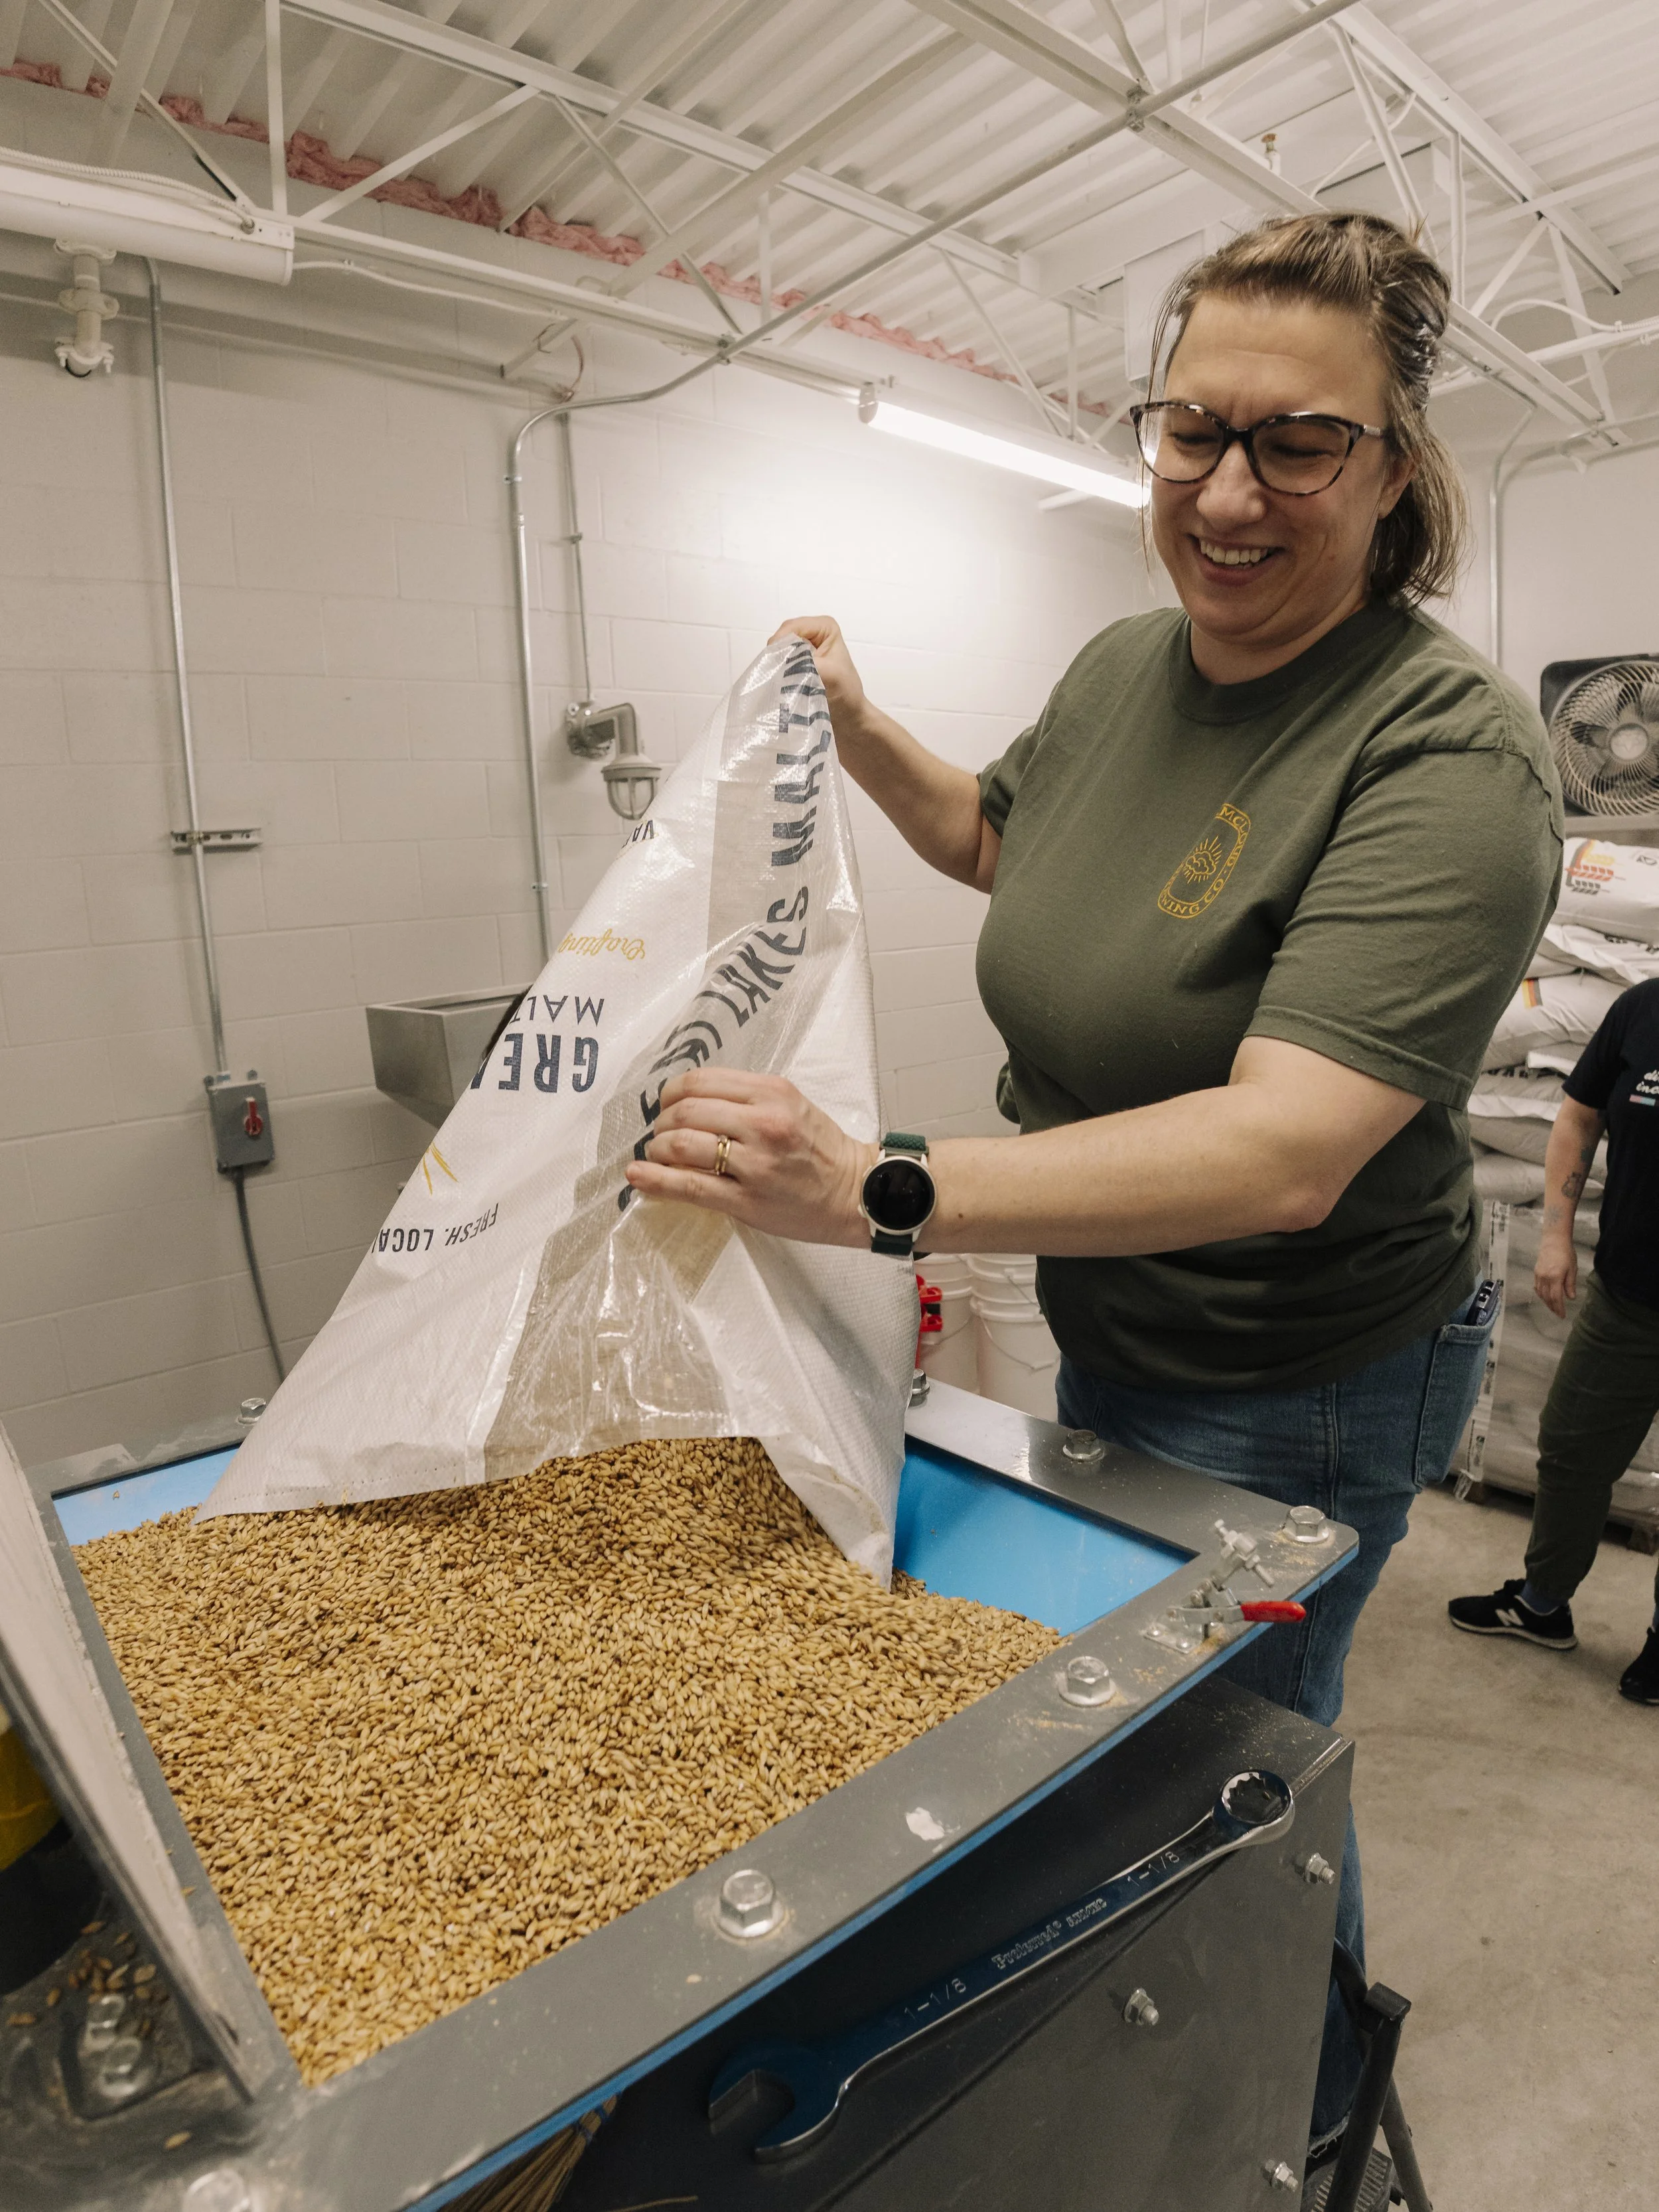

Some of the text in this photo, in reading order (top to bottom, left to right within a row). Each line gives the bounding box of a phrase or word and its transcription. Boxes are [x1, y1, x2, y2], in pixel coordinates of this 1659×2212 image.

[621, 820, 655, 849] VA
[693, 885, 809, 1029] LAKES
[770, 640, 832, 867] MALTIN
[445, 1202, 499, 1246] FRESH.
[904, 1978, 966, 2021] 1-1/8
[1127, 1851, 1180, 1887] 1-1/8
